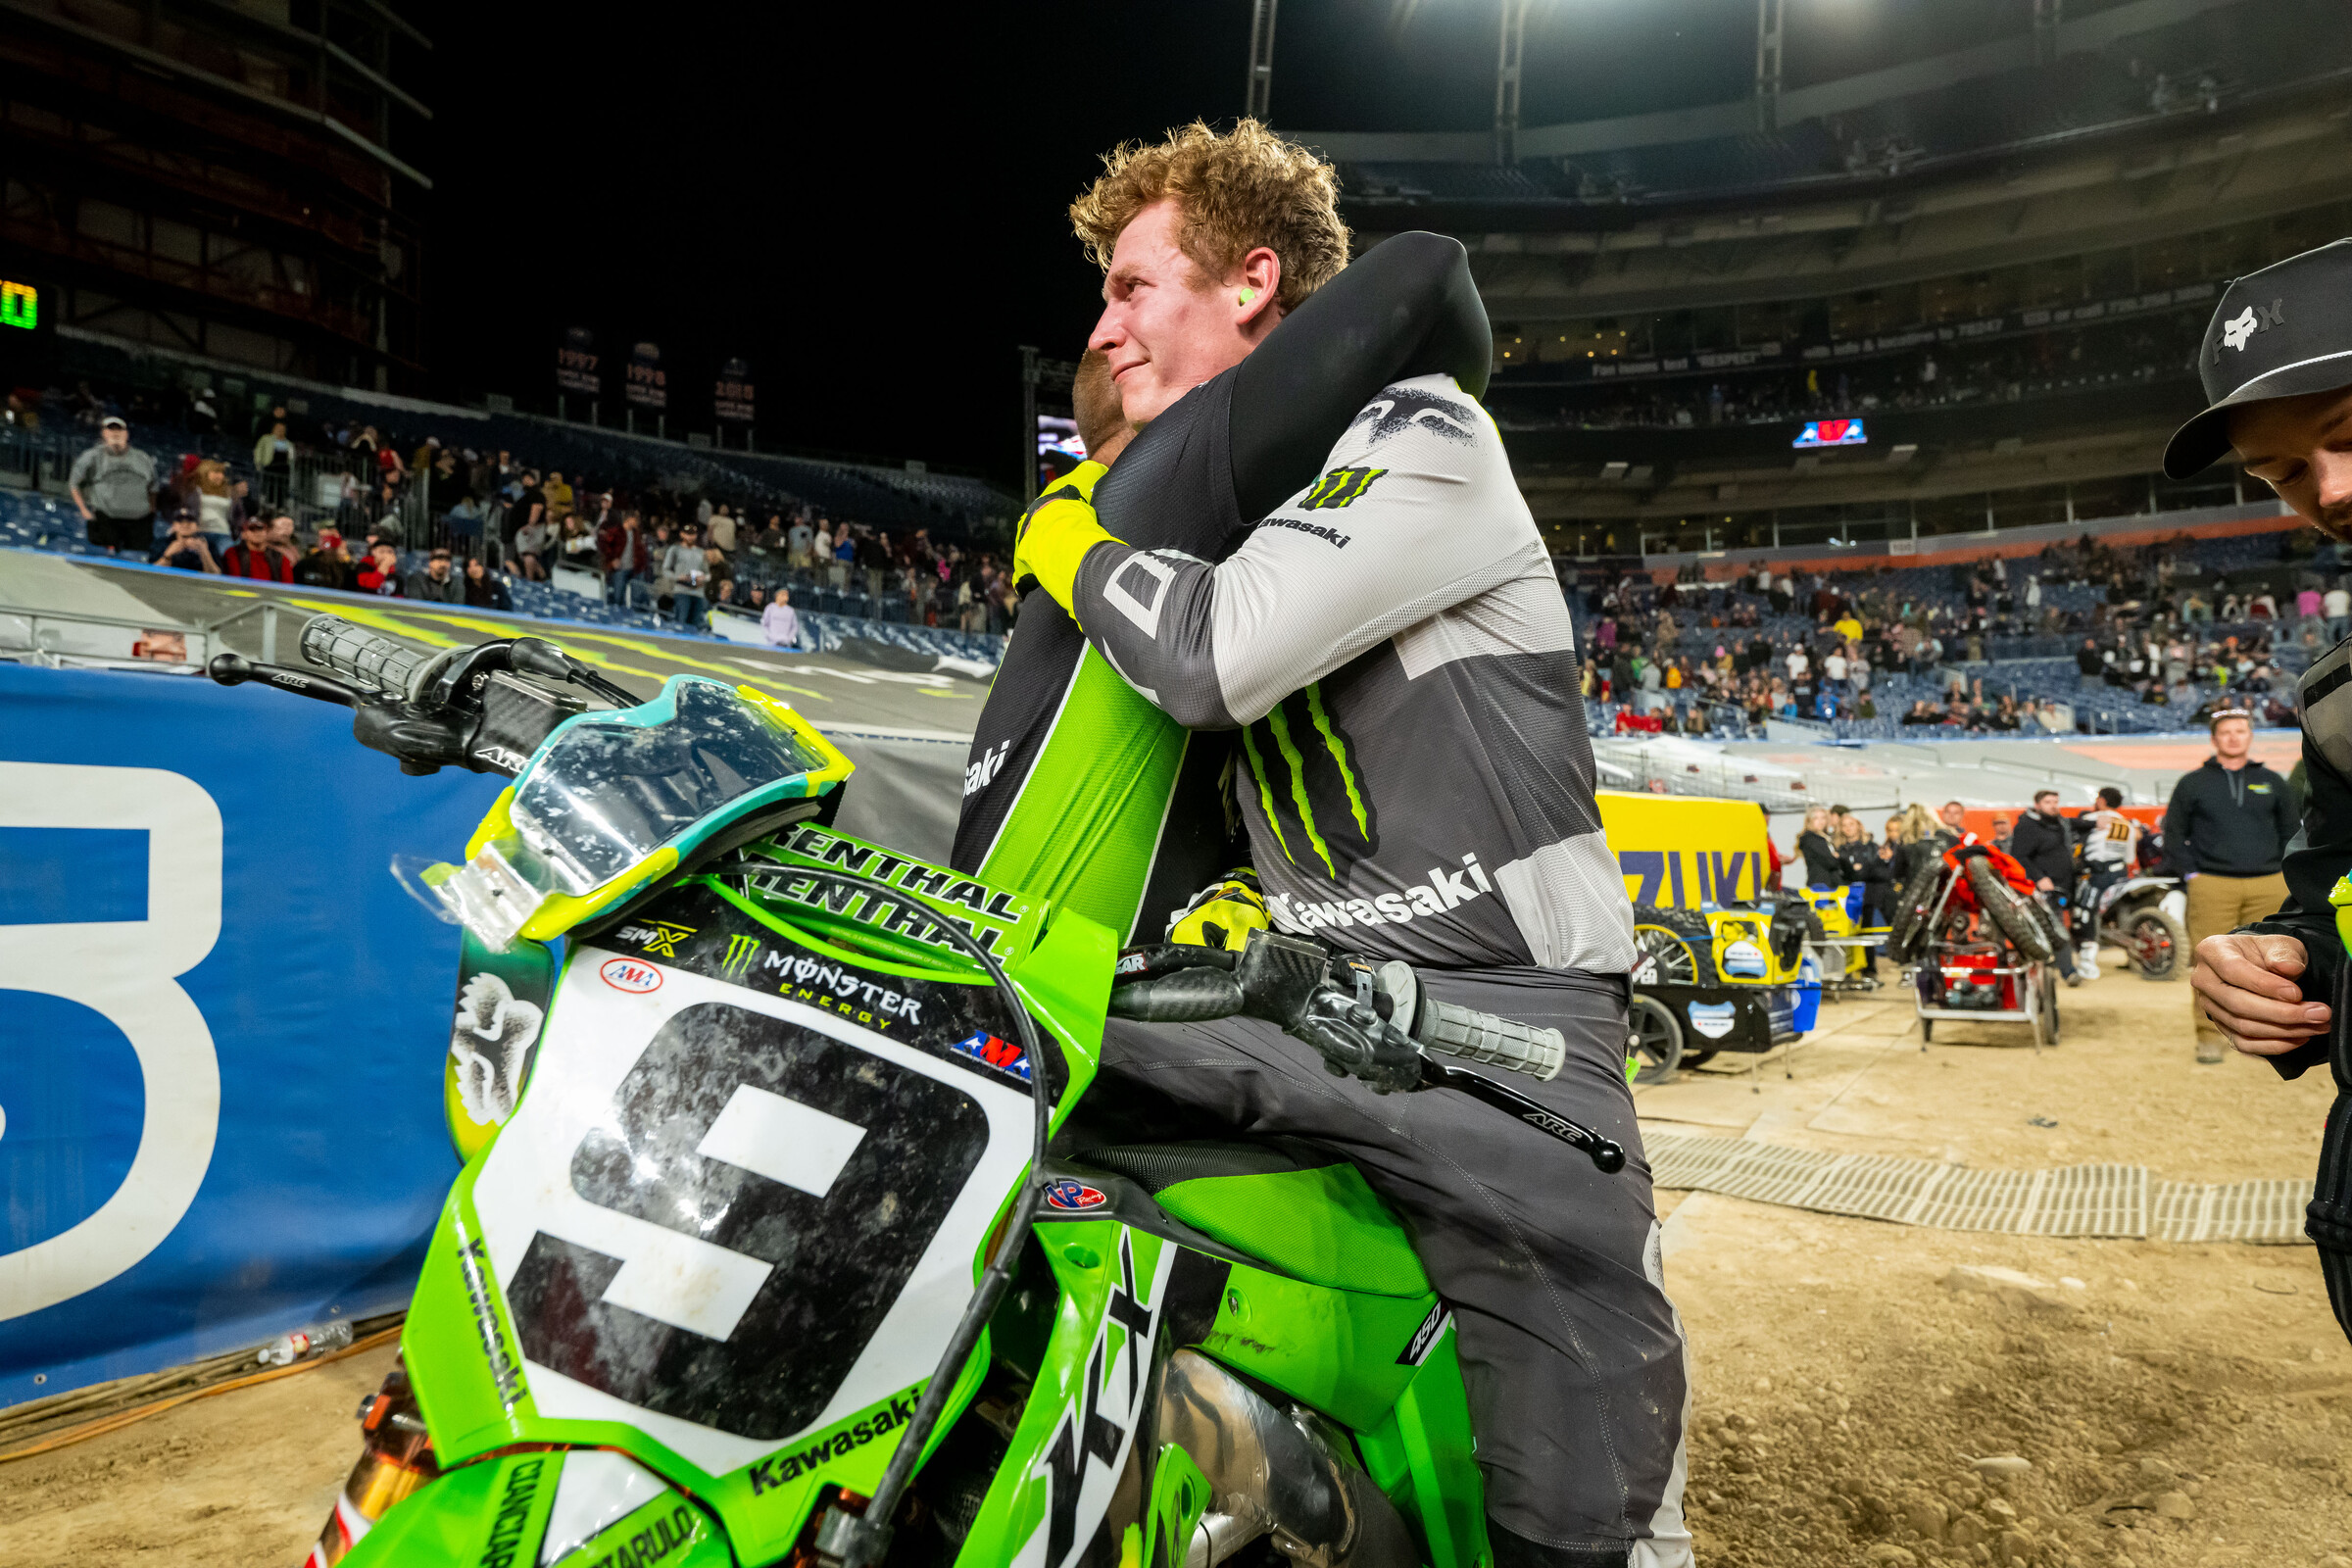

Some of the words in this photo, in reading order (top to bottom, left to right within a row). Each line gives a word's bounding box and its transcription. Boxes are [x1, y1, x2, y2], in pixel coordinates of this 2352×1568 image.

[1257, 517, 1351, 550] awasaki
[271, 672, 310, 689] ARC
[615, 925, 690, 958] SMX
[609, 965, 654, 987] AMA
[779, 982, 891, 1030] ENERGY
[1522, 1112, 1583, 1144] ARC
[1045, 1181, 1084, 1208] VP
[458, 1238, 528, 1411] Kawasaki
[1409, 1299, 1442, 1361] 450
[748, 1388, 922, 1496] Kawasaki
